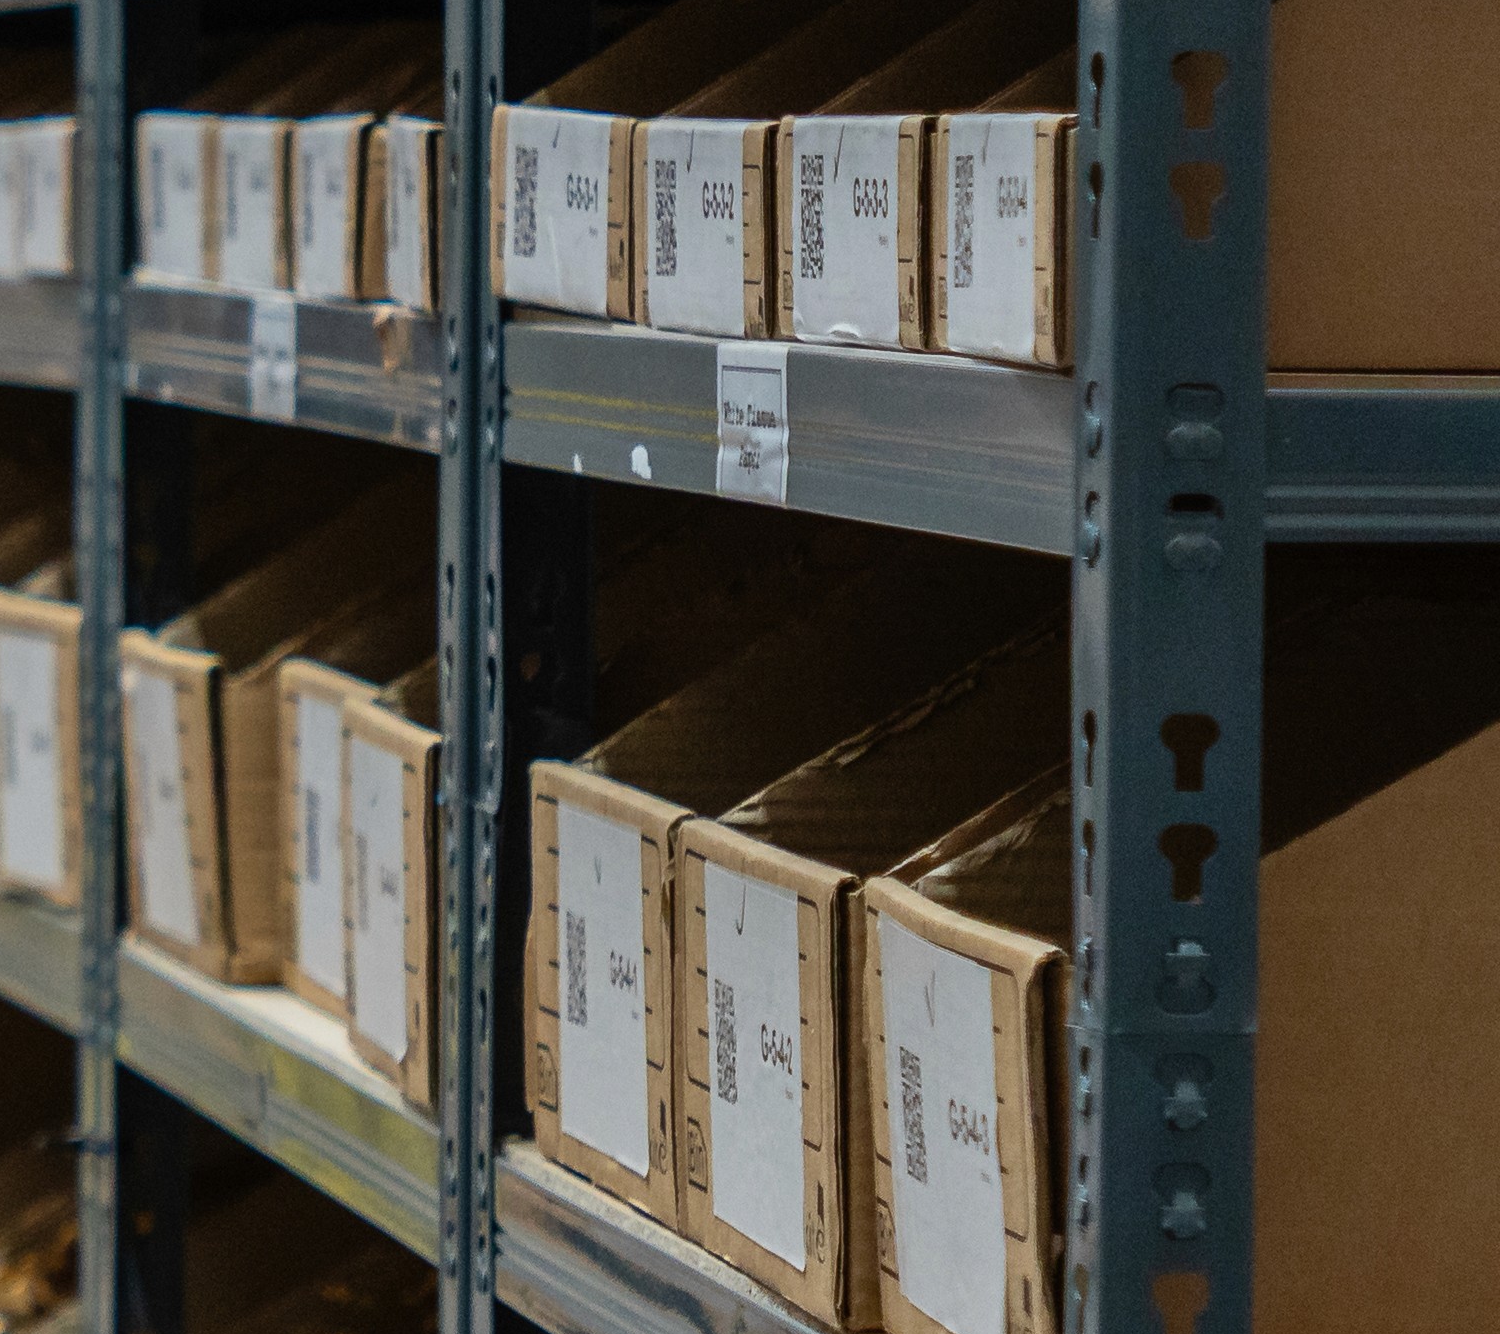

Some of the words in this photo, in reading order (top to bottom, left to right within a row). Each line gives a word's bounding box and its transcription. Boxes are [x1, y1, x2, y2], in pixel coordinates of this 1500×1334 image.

[566, 173, 599, 213] G-5-3-1
[702, 181, 735, 220] G-5-3-2
[853, 177, 889, 219] G-5-3-3
[747, 404, 777, 429] Tissue
[738, 444, 761, 475] Paper
[761, 1024, 793, 1076] G-5-4-2
